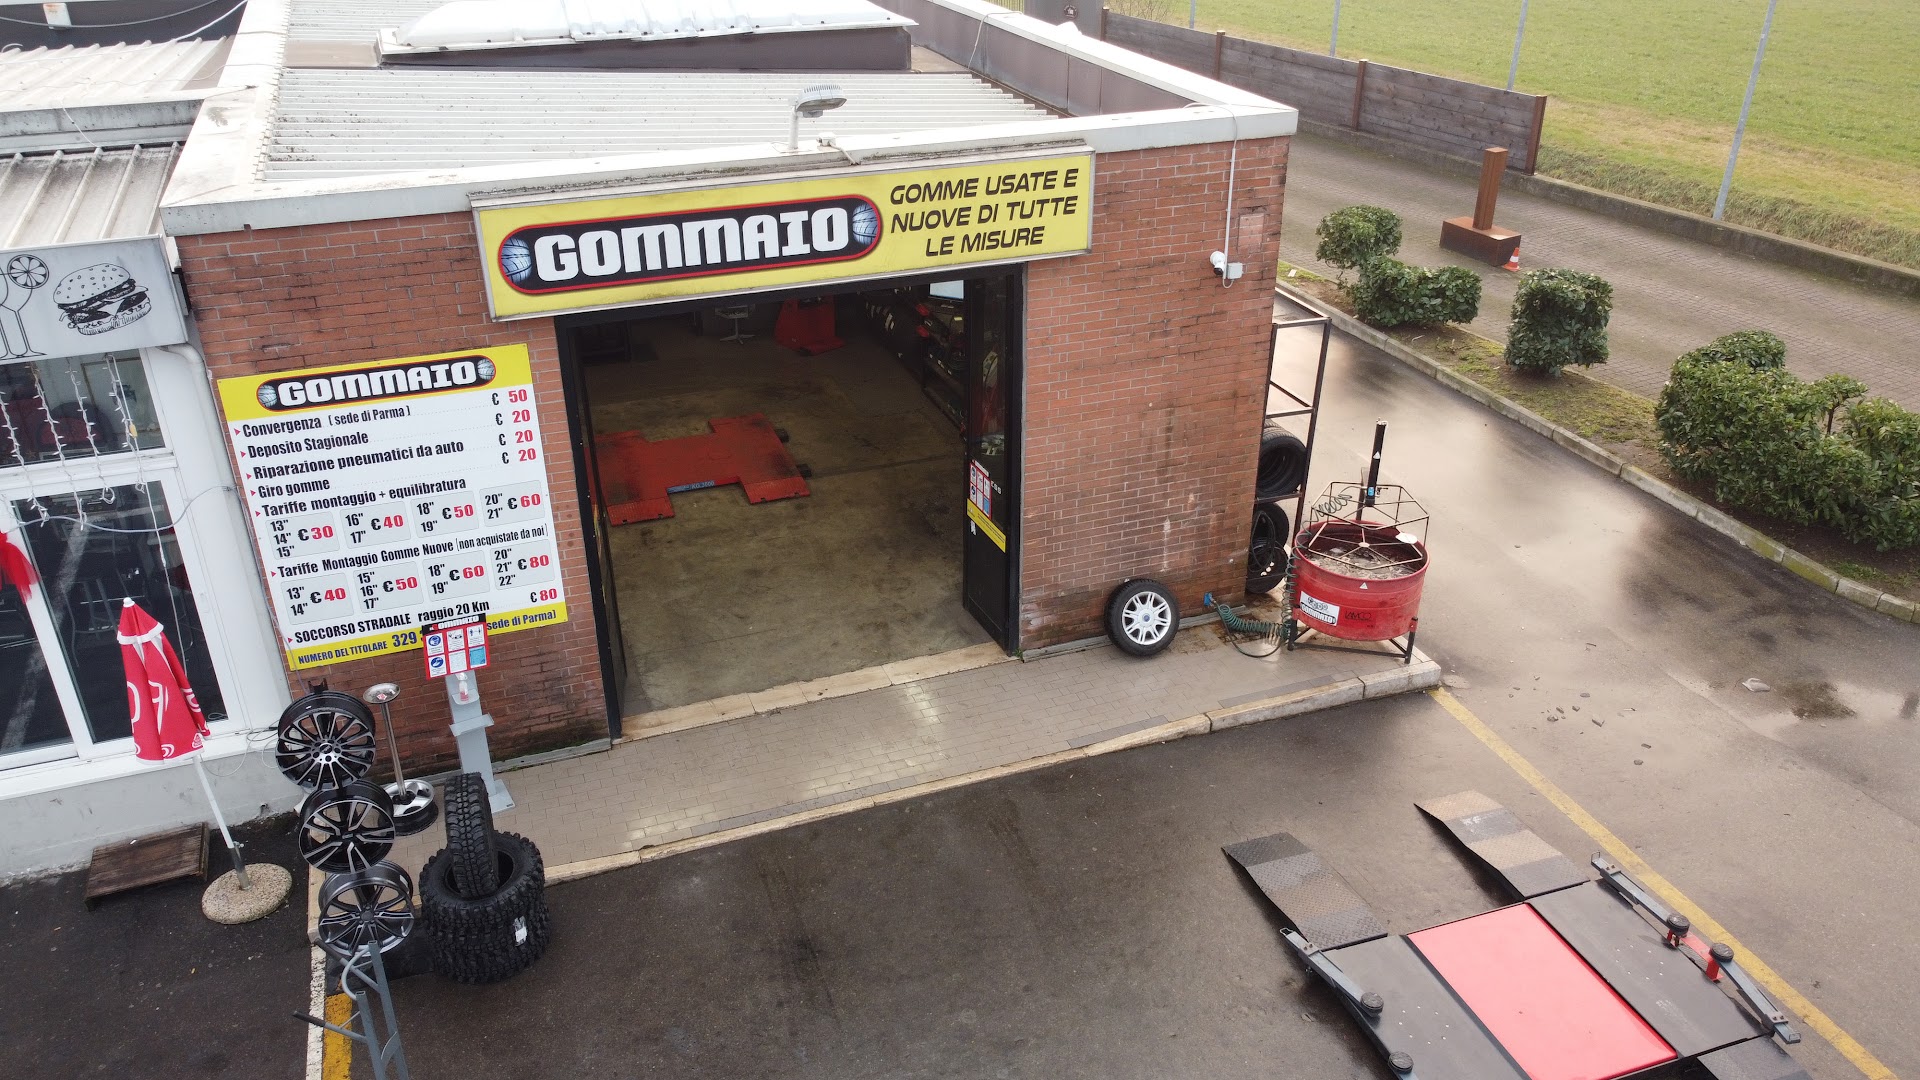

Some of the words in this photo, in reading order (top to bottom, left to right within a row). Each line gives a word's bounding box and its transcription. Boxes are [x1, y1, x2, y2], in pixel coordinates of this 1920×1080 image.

[890, 177, 979, 205] GOMME
[985, 170, 1058, 196] USATE
[1063, 168, 1079, 188] E
[890, 206, 971, 233] NUOVE
[977, 203, 999, 224] DI
[1006, 195, 1078, 221] TUTTE
[534, 207, 849, 282] GOMMAIO
[925, 235, 954, 256] LE
[960, 225, 1045, 253] MISURE
[277, 361, 477, 406] GOMMAIO
[242, 417, 322, 437] Convergenza
[335, 411, 360, 425] sede
[361, 410, 371, 421] di
[373, 407, 405, 420] Parma
[491, 392, 500, 405] €
[508, 389, 528, 403] 50
[247, 440, 303, 458] Deposito
[303, 431, 369, 451] Stagionale
[495, 412, 503, 425] €
[511, 409, 531, 423] 20
[253, 459, 335, 479] Riparazione
[337, 447, 414, 470] pneumatici
[416, 444, 433, 458] da
[435, 441, 464, 455] auto
[498, 433, 506, 446] €
[514, 429, 534, 443] 20
[257, 484, 283, 498] Giro
[285, 479, 330, 496] gomme
[501, 451, 509, 464] €
[518, 447, 537, 462] 20
[261, 500, 307, 517] Tariffe
[310, 490, 376, 511] montaggio
[389, 478, 466, 500] equilibratura
[277, 562, 318, 578] Tariffe
[322, 552, 378, 571] Montaggio
[380, 546, 420, 563] Gomme
[422, 541, 454, 556] Nuove
[476, 530, 519, 547] acquistate
[520, 528, 531, 540] da
[294, 622, 356, 644] SOCCORSO
[357, 613, 412, 633] STRADALE
[417, 606, 454, 622] raggio
[455, 603, 470, 616] 20
[471, 601, 490, 614] Km
[539, 588, 558, 601] 80
[298, 651, 334, 665] NUMERO
[335, 646, 350, 658] DEL
[350, 640, 388, 655] TITOLARE
[391, 631, 418, 648] 329
[512, 615, 522, 626] di
